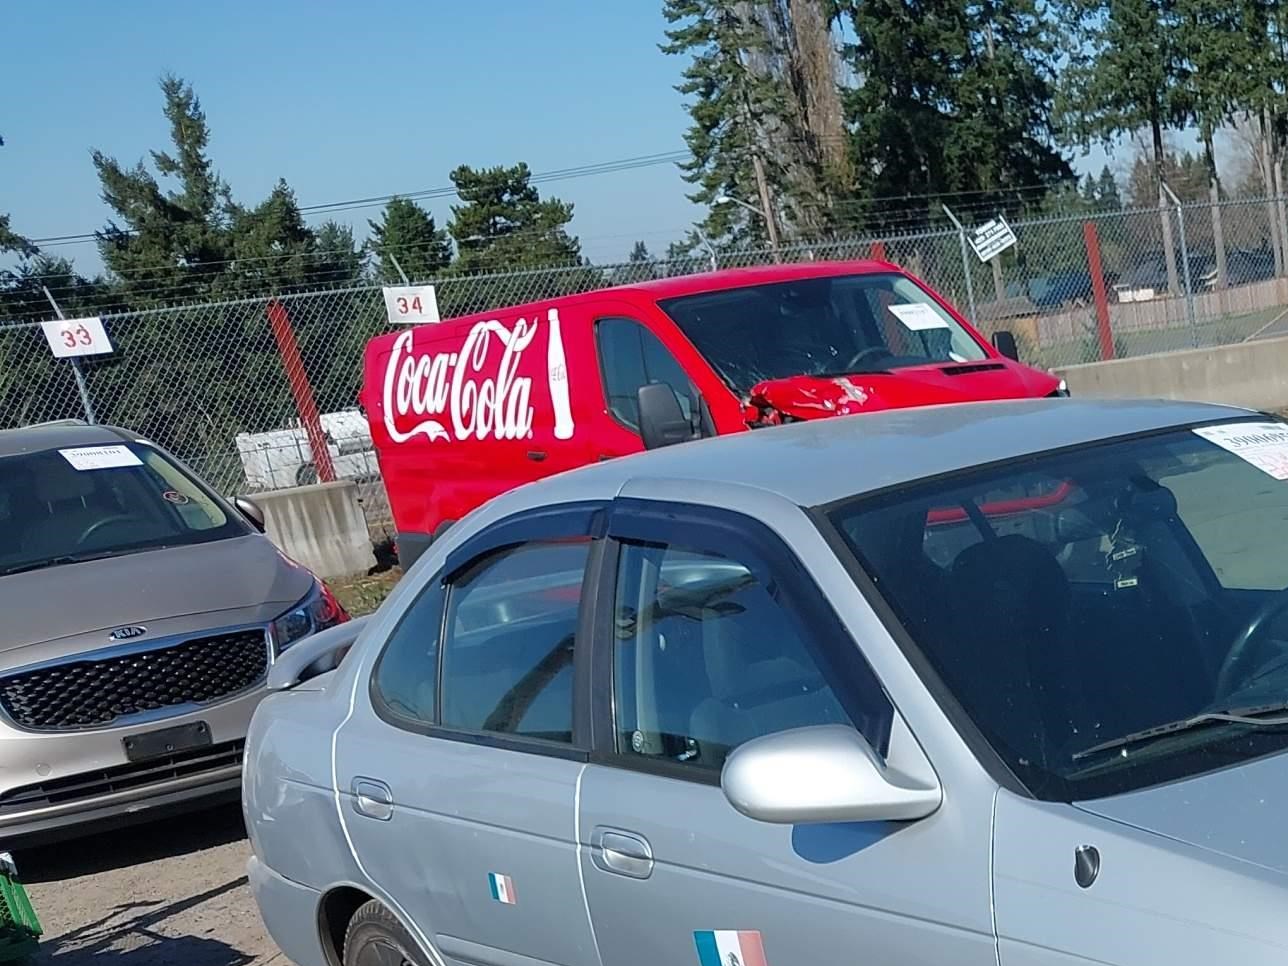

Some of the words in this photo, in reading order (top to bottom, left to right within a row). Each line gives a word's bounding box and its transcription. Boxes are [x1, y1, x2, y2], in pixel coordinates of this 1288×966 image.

[396, 296, 423, 314] 34
[61, 325, 92, 347] 33
[383, 317, 538, 443] Coca-Cola
[114, 627, 141, 638] KIA
